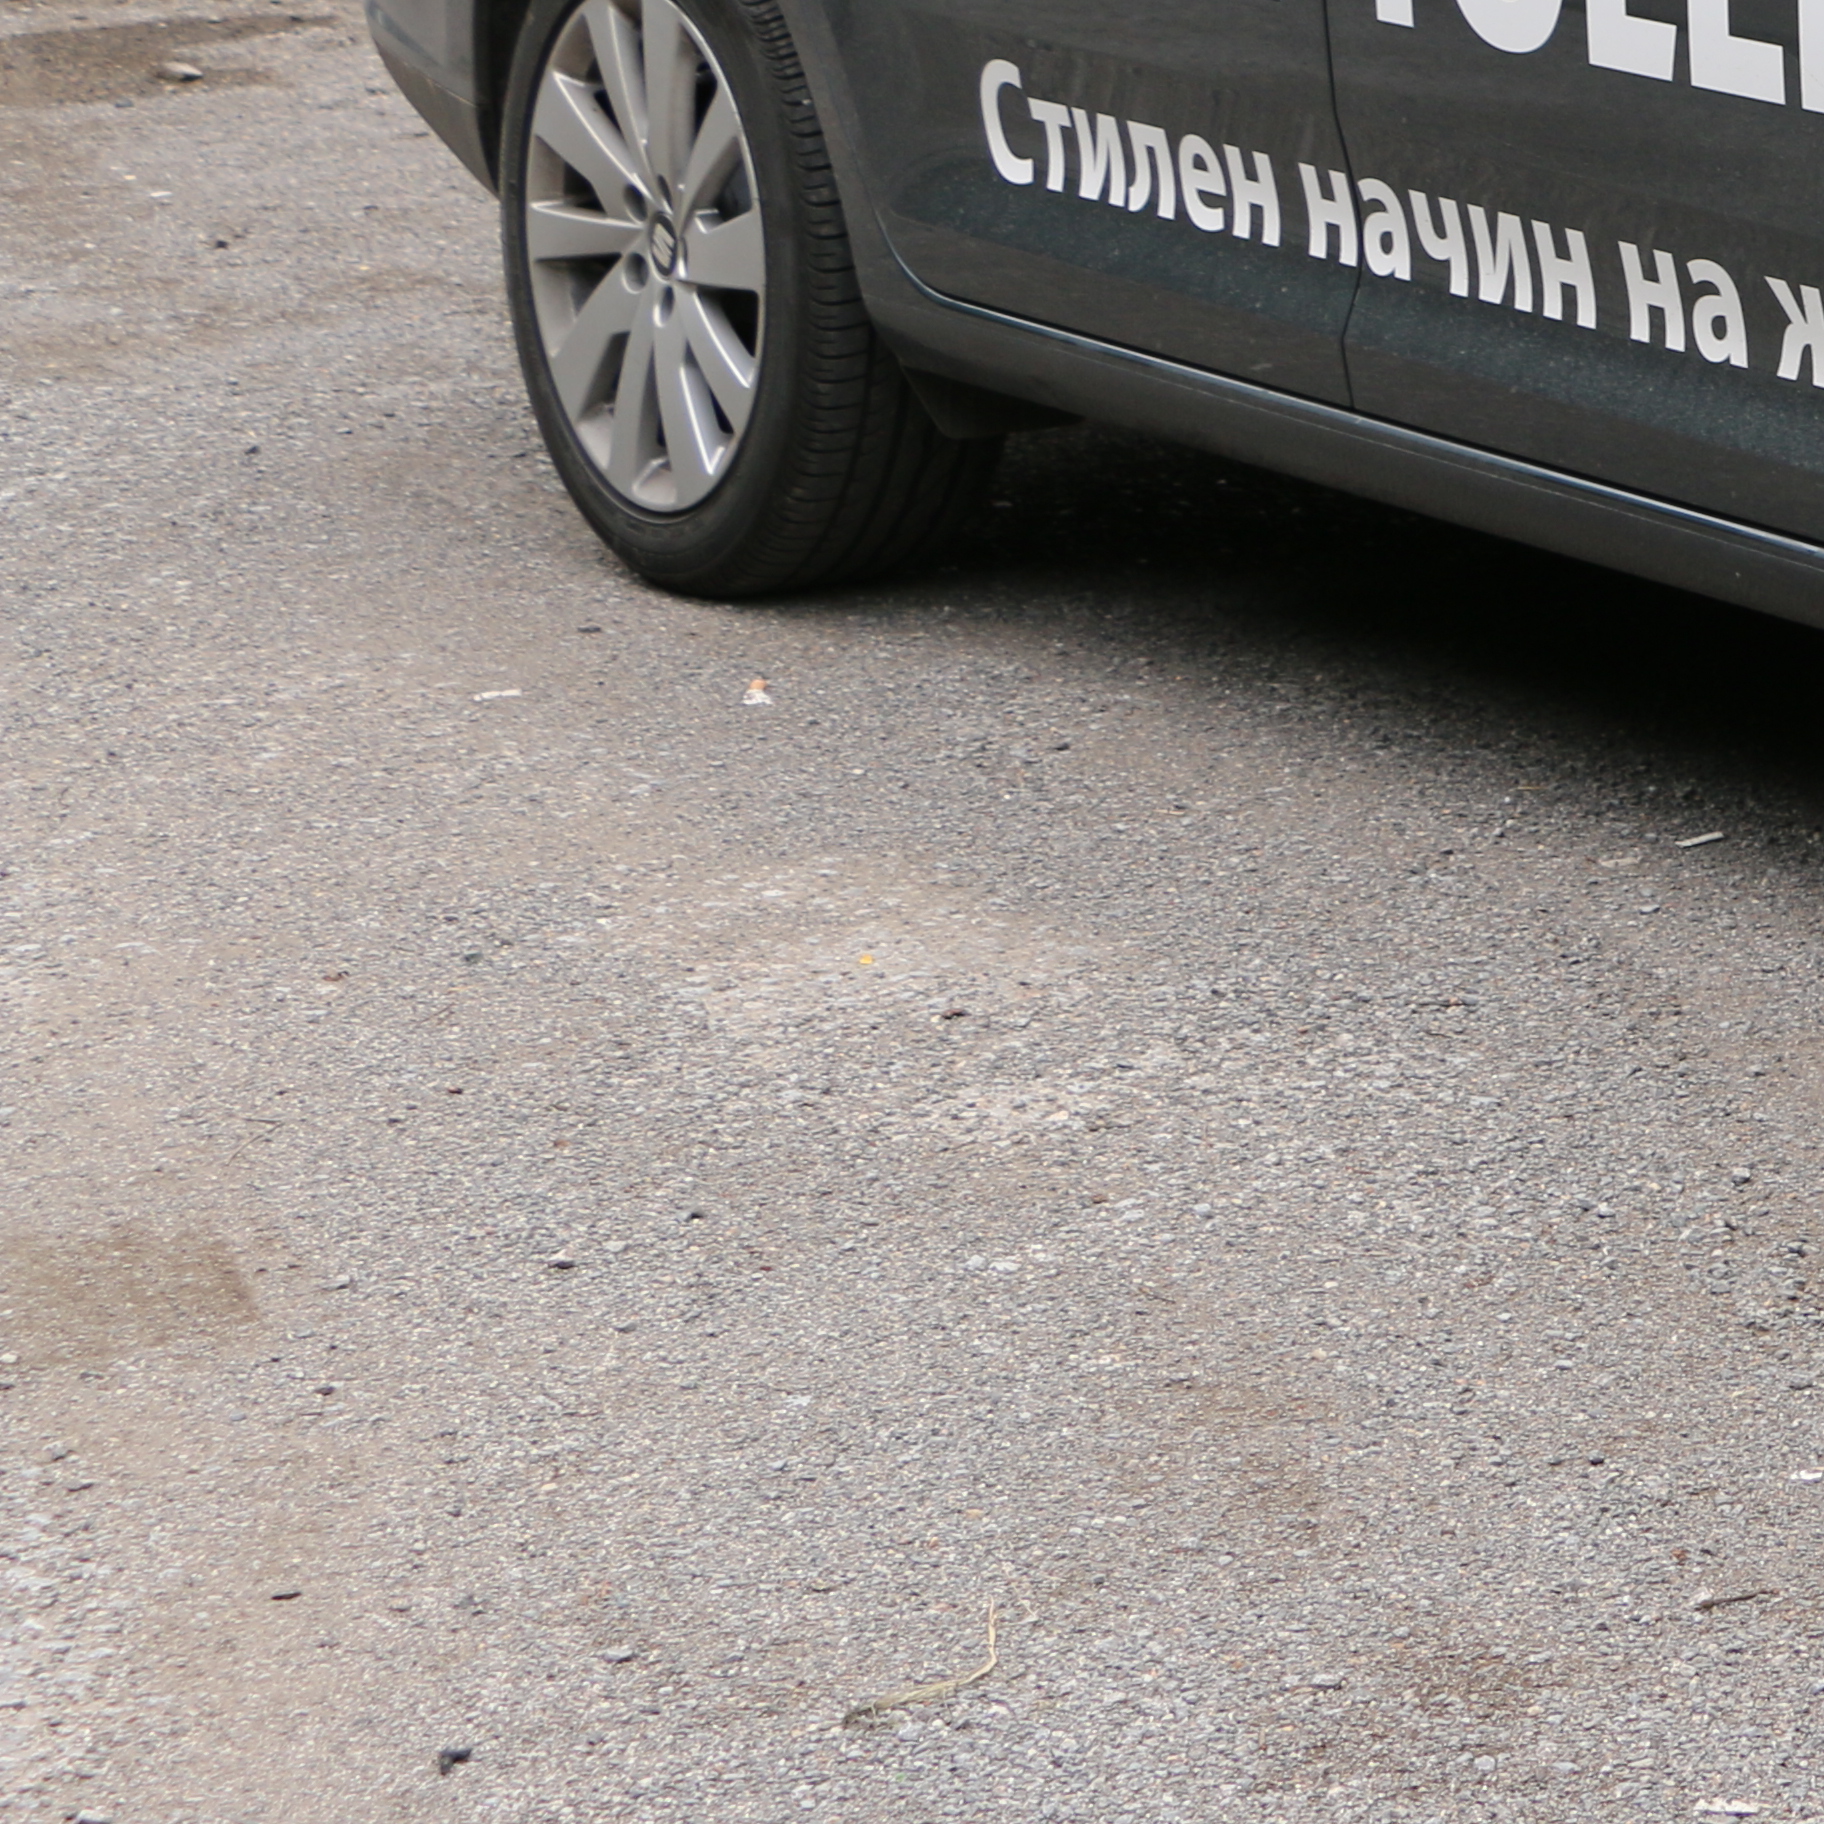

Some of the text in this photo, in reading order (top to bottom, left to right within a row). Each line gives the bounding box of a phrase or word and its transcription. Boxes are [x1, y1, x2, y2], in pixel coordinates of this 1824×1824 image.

[980, 59, 1281, 247] Стилен
[1298, 162, 1597, 330] начин
[1617, 240, 1749, 369] на
